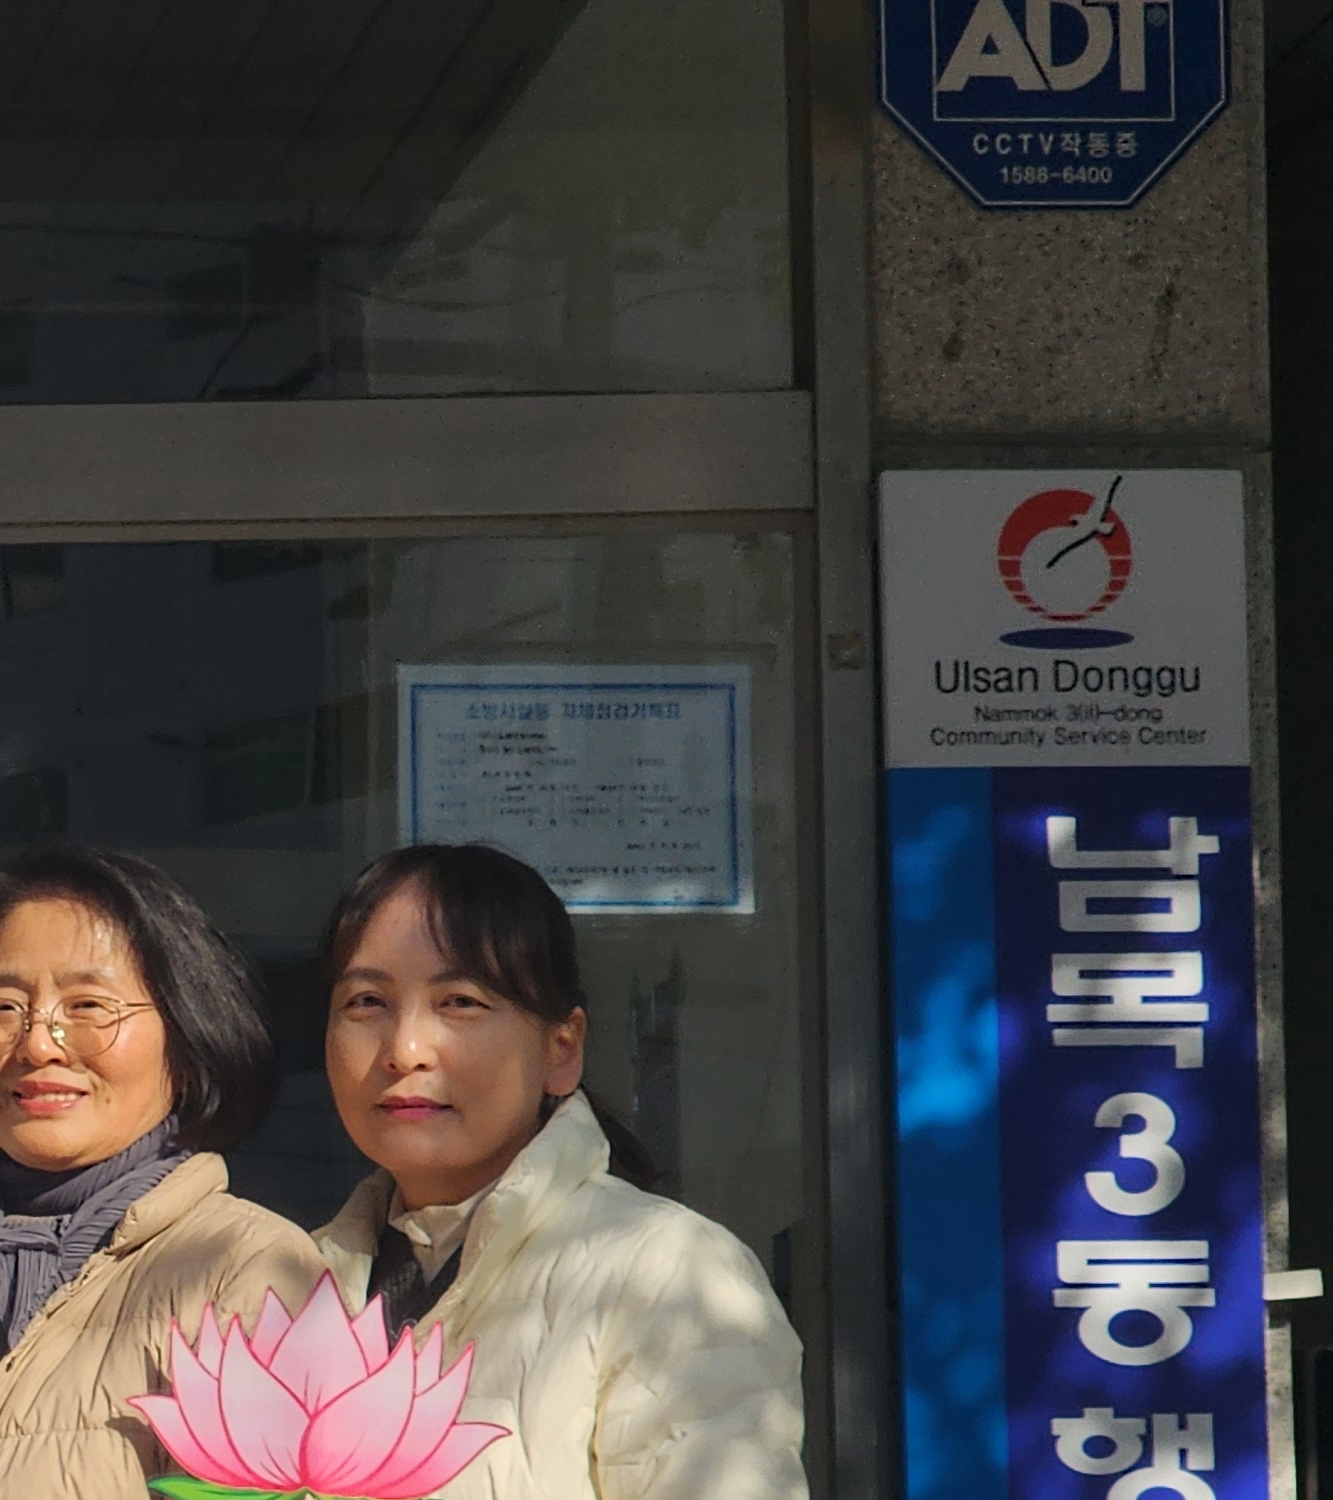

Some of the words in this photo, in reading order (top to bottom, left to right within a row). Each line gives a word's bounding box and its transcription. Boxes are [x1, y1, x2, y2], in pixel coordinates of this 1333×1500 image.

[936, 0, 1169, 92] ADT
[972, 132, 1139, 158] CCTV작동중
[999, 165, 1114, 185] 1588-6400
[934, 660, 1039, 694] Ulsan
[1053, 660, 1201, 697] Donggu
[974, 705, 1056, 722] Nammok
[930, 727, 1045, 747] Community
[1054, 727, 1130, 746] Service
[1138, 727, 1206, 745] Center
